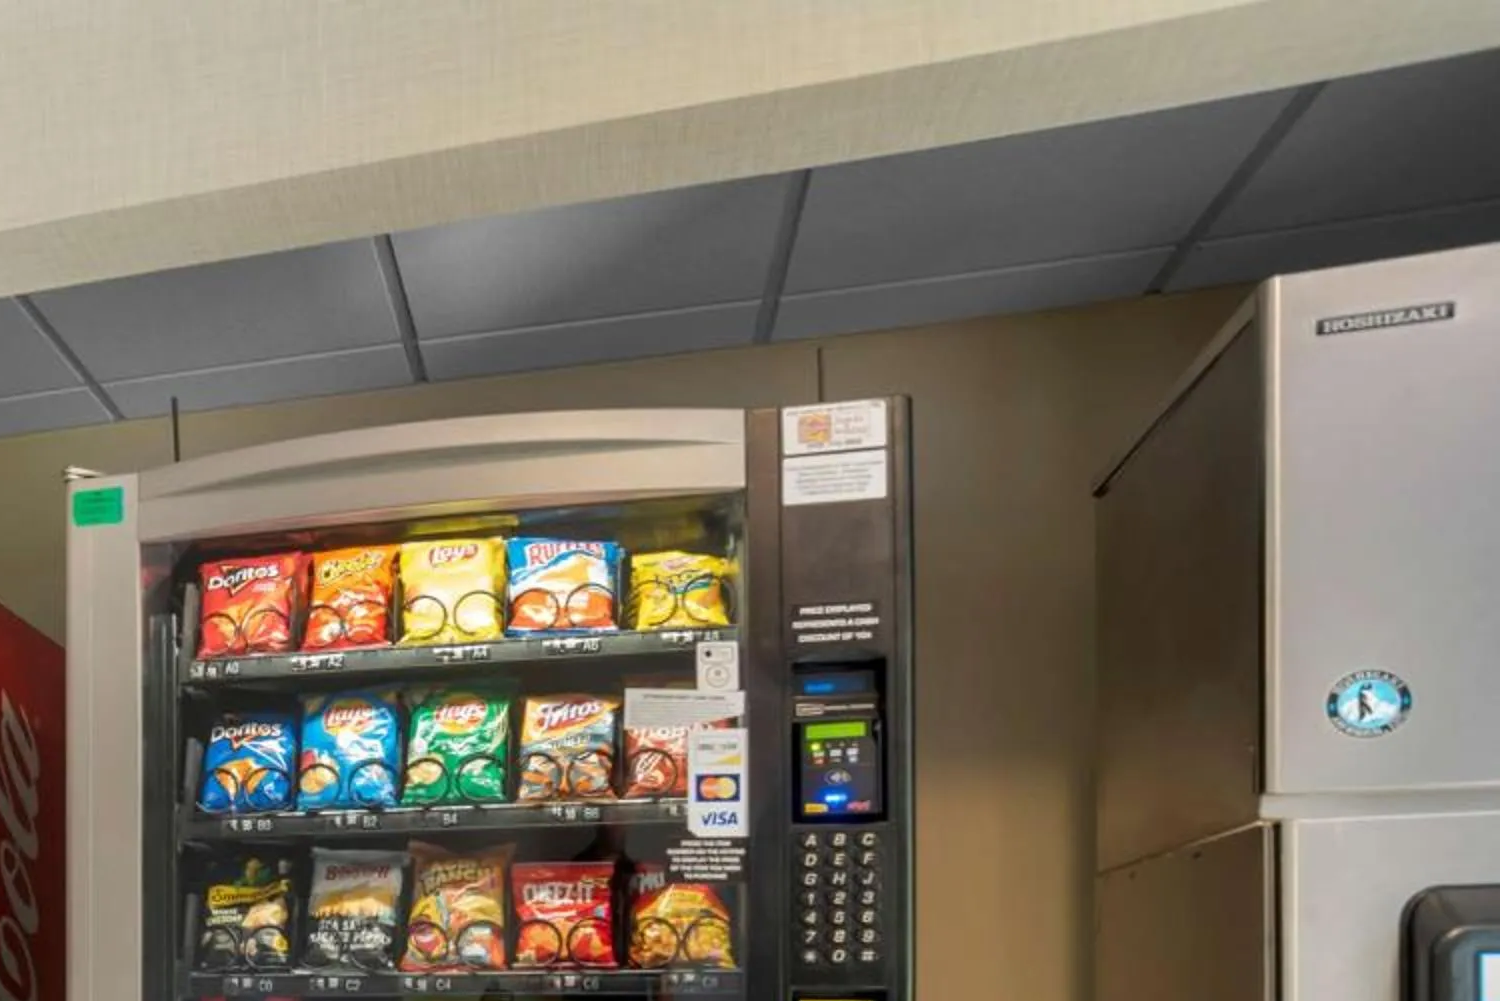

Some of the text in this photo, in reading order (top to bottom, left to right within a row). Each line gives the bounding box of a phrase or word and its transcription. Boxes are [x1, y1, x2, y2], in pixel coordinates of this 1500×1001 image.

[207, 564, 280, 590] Doritos
[537, 701, 602, 730] Fritos
[211, 723, 283, 743] Doritos
[702, 811, 738, 826] VISA
[805, 833, 876, 846] A B C
[804, 852, 875, 867] D E F
[832, 872, 846, 885] H
[862, 872, 874, 885] J
[522, 881, 594, 903] CHEEZ-IT
[808, 891, 875, 905] 1 2 3
[805, 911, 874, 924] 4 5 6
[805, 930, 875, 943] 7 8 9
